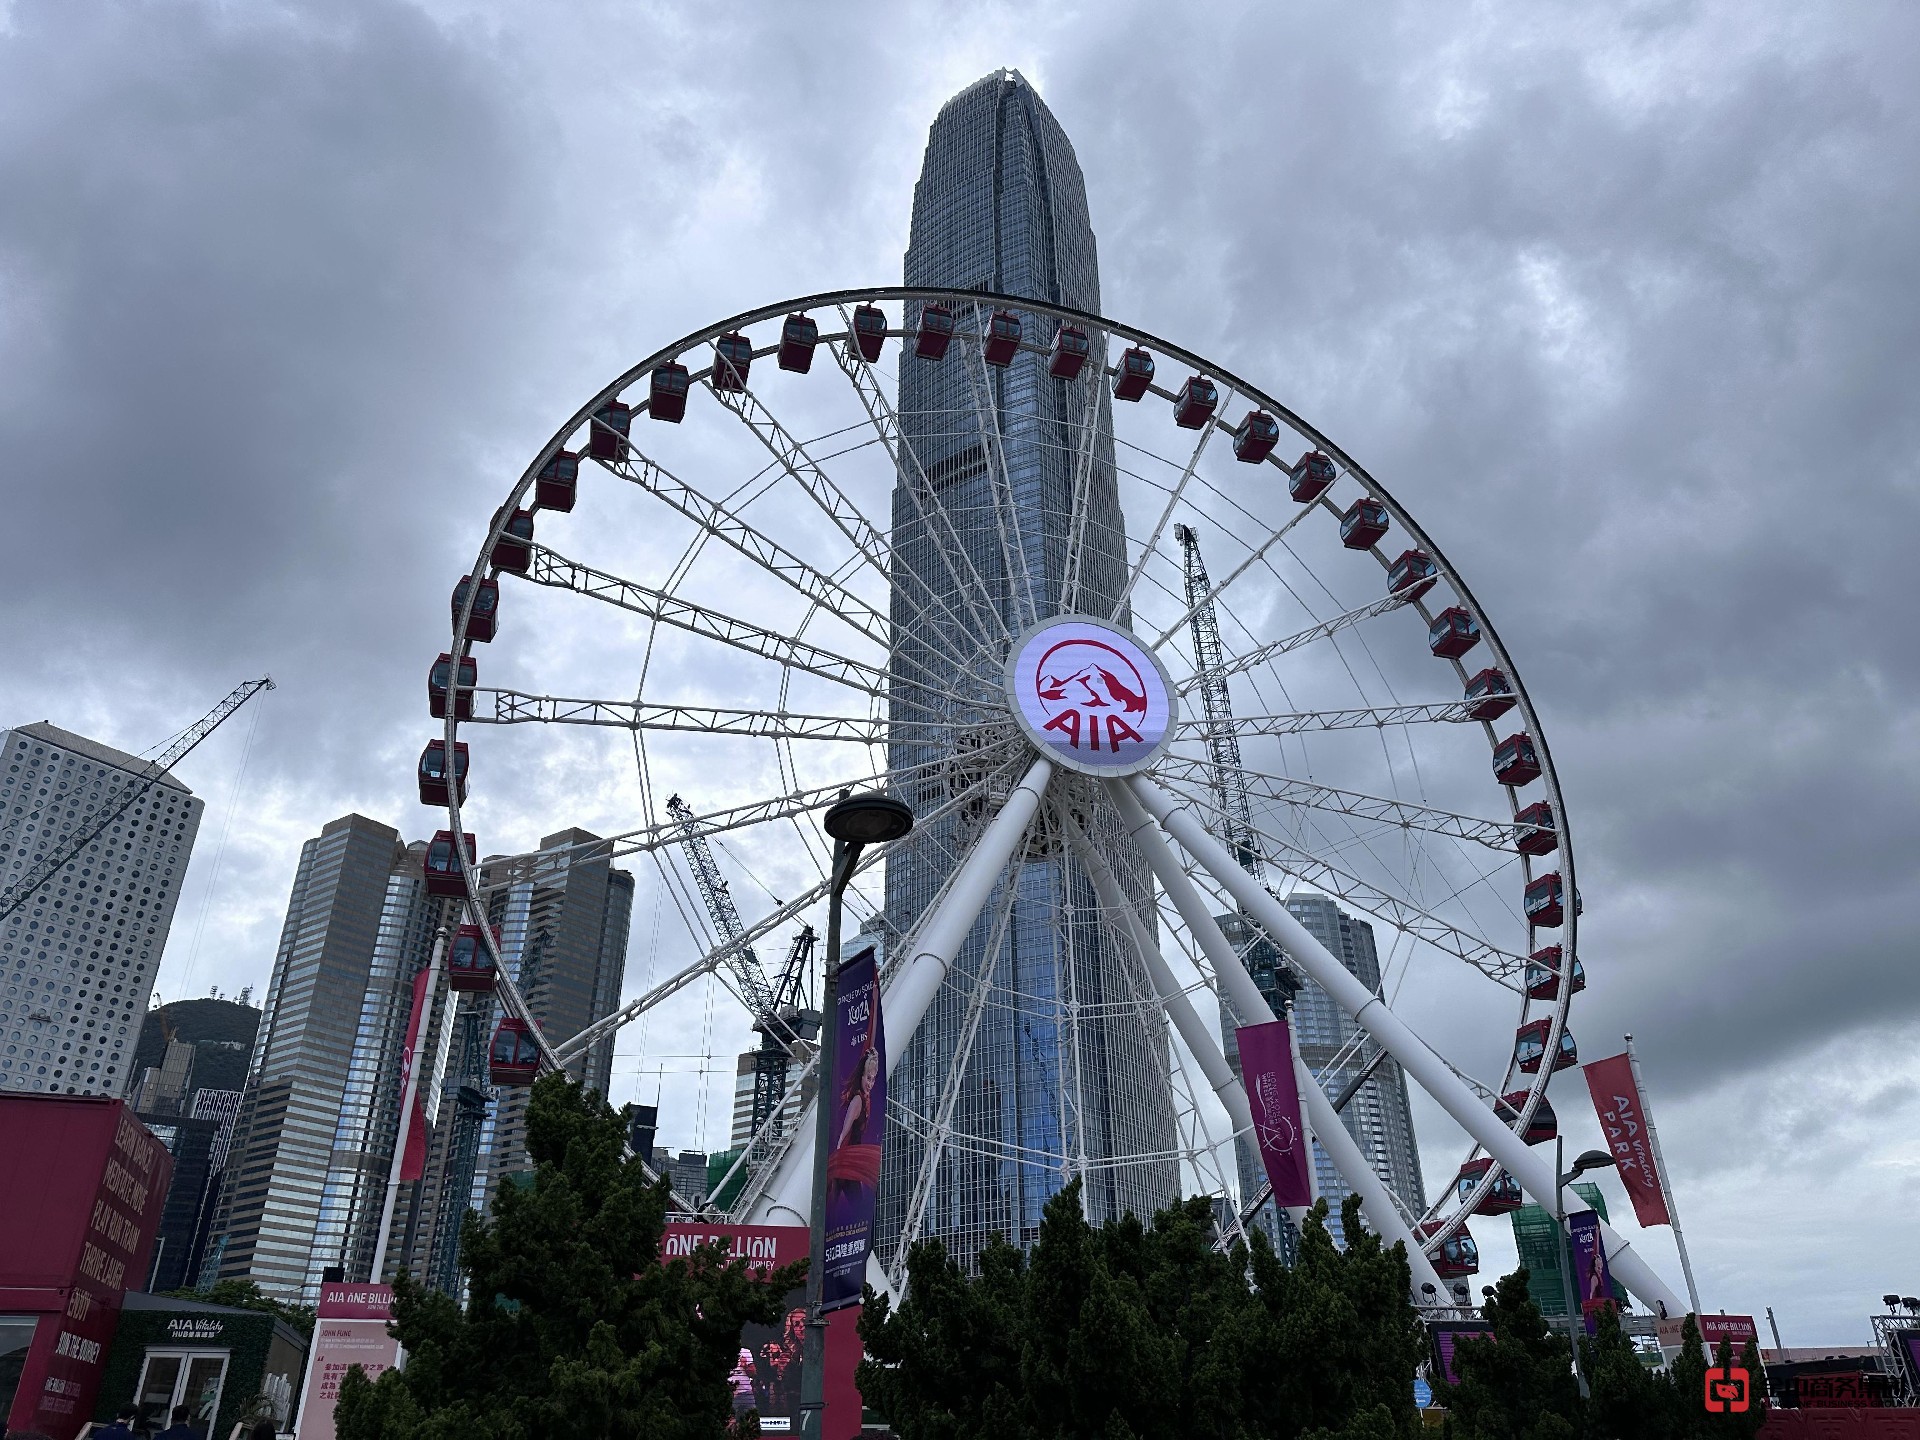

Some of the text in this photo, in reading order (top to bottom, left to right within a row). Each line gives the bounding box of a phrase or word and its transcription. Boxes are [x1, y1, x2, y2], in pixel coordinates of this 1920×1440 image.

[1042, 708, 1144, 754] AIA
[115, 1115, 139, 1158] LEARN
[1603, 1110, 1637, 1171] PARK
[1613, 1095, 1654, 1188] AIA Vitality
[103, 1157, 149, 1216] MEDITATE MOVE
[91, 1199, 141, 1255] PLAY RUN TRAIN
[708, 1235, 777, 1259] BLLION
[80, 1241, 126, 1291] THRIVE LAUGH
[67, 1286, 92, 1322] ENJOY
[327, 1291, 345, 1303] AIA
[166, 1317, 224, 1334] AIA Vitality
[171, 1330, 189, 1338] HUB
[321, 1329, 336, 1337] JOHN
[1706, 1321, 1717, 1331] AIA
[69, 1334, 82, 1360] THE
[78, 1338, 102, 1365] JOURNEY
